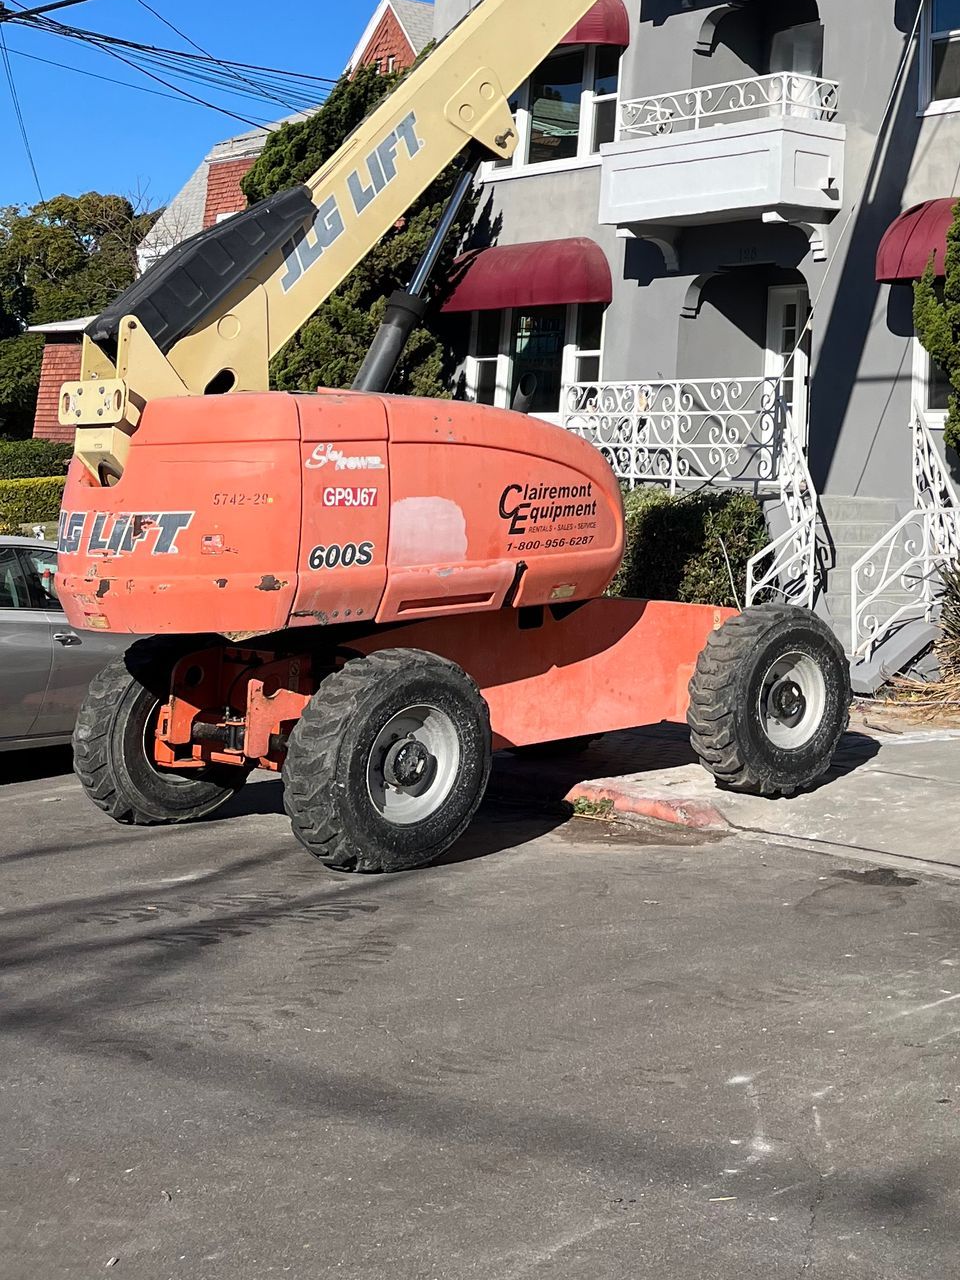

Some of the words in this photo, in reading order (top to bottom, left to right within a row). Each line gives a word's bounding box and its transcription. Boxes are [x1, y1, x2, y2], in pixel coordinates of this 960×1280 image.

[280, 193, 345, 296] JLG
[346, 109, 418, 217] LIFT
[323, 487, 377, 506] GP9J67
[499, 482, 592, 519] Clairemont
[508, 499, 597, 535] Equipment
[528, 525, 553, 533] RENTALS
[87, 511, 195, 557] LIFT
[507, 535, 595, 551] 1-800-956-6287
[308, 541, 375, 570] 600S
